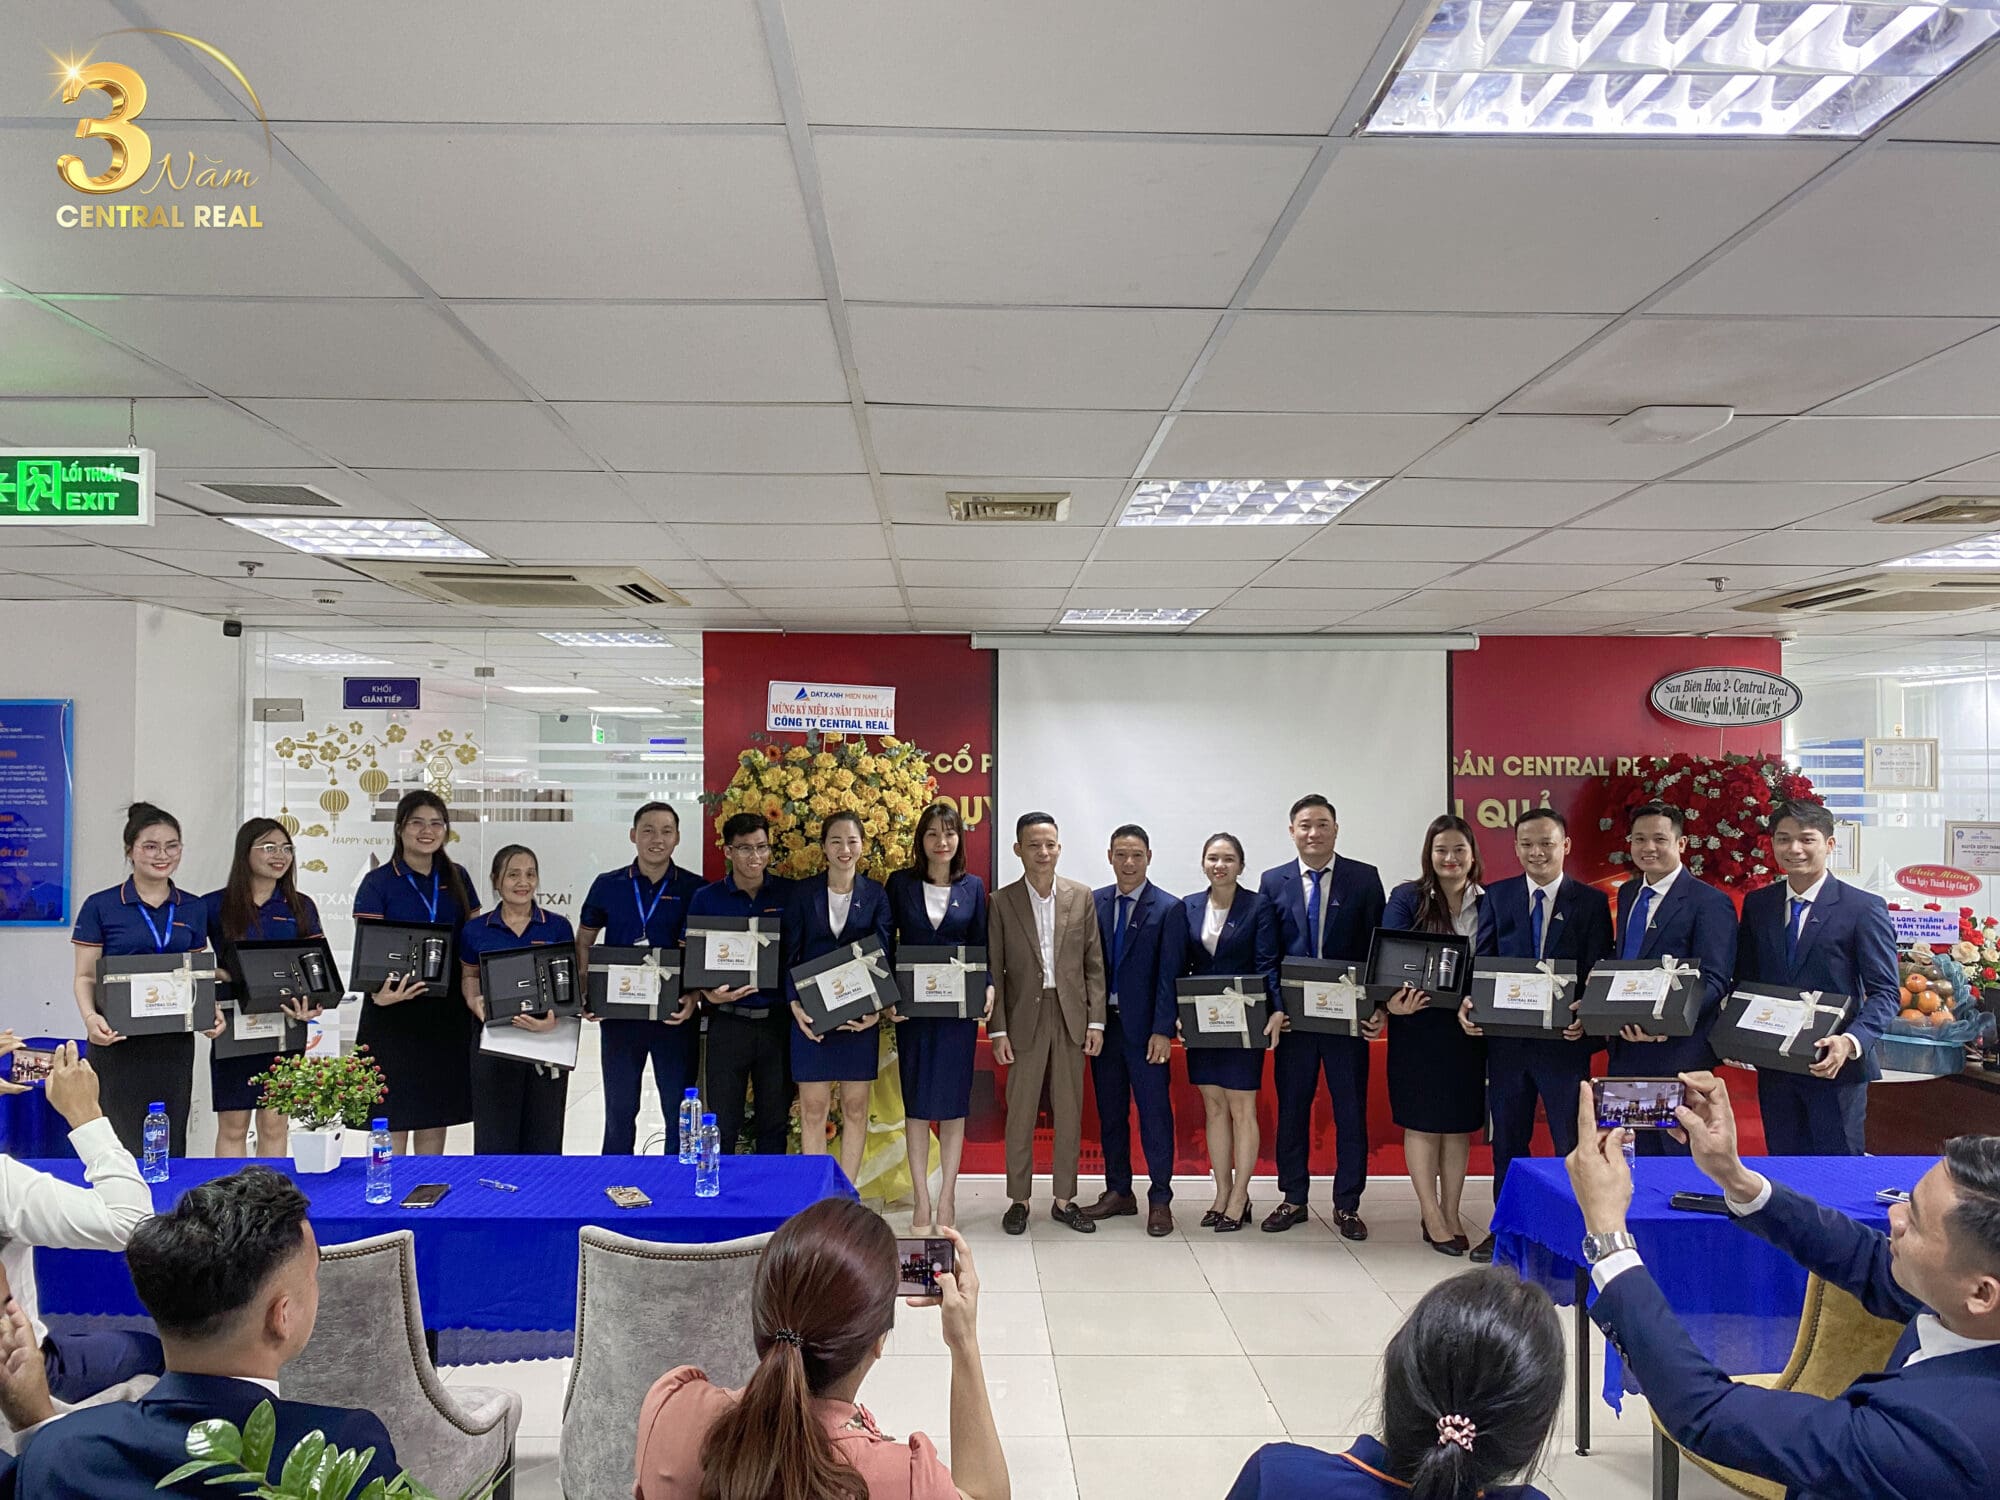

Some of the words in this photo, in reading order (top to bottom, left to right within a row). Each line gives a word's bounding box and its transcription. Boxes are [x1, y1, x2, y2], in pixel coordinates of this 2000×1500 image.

[65, 492, 120, 511] EXIT
[810, 691, 843, 699] DATXANH
[1733, 679, 1766, 694] Central
[1768, 682, 1789, 697] Real
[829, 706, 834, 716] 3
[774, 715, 803, 727] CÔNG
[805, 717, 817, 728] TY
[819, 718, 863, 729] CENTRAL
[865, 720, 890, 730] REAL
[933, 743, 974, 774] CỔ
[1502, 756, 1610, 777] CENTRAL
[332, 836, 360, 845] HAPPY
[363, 837, 382, 846] NEW
